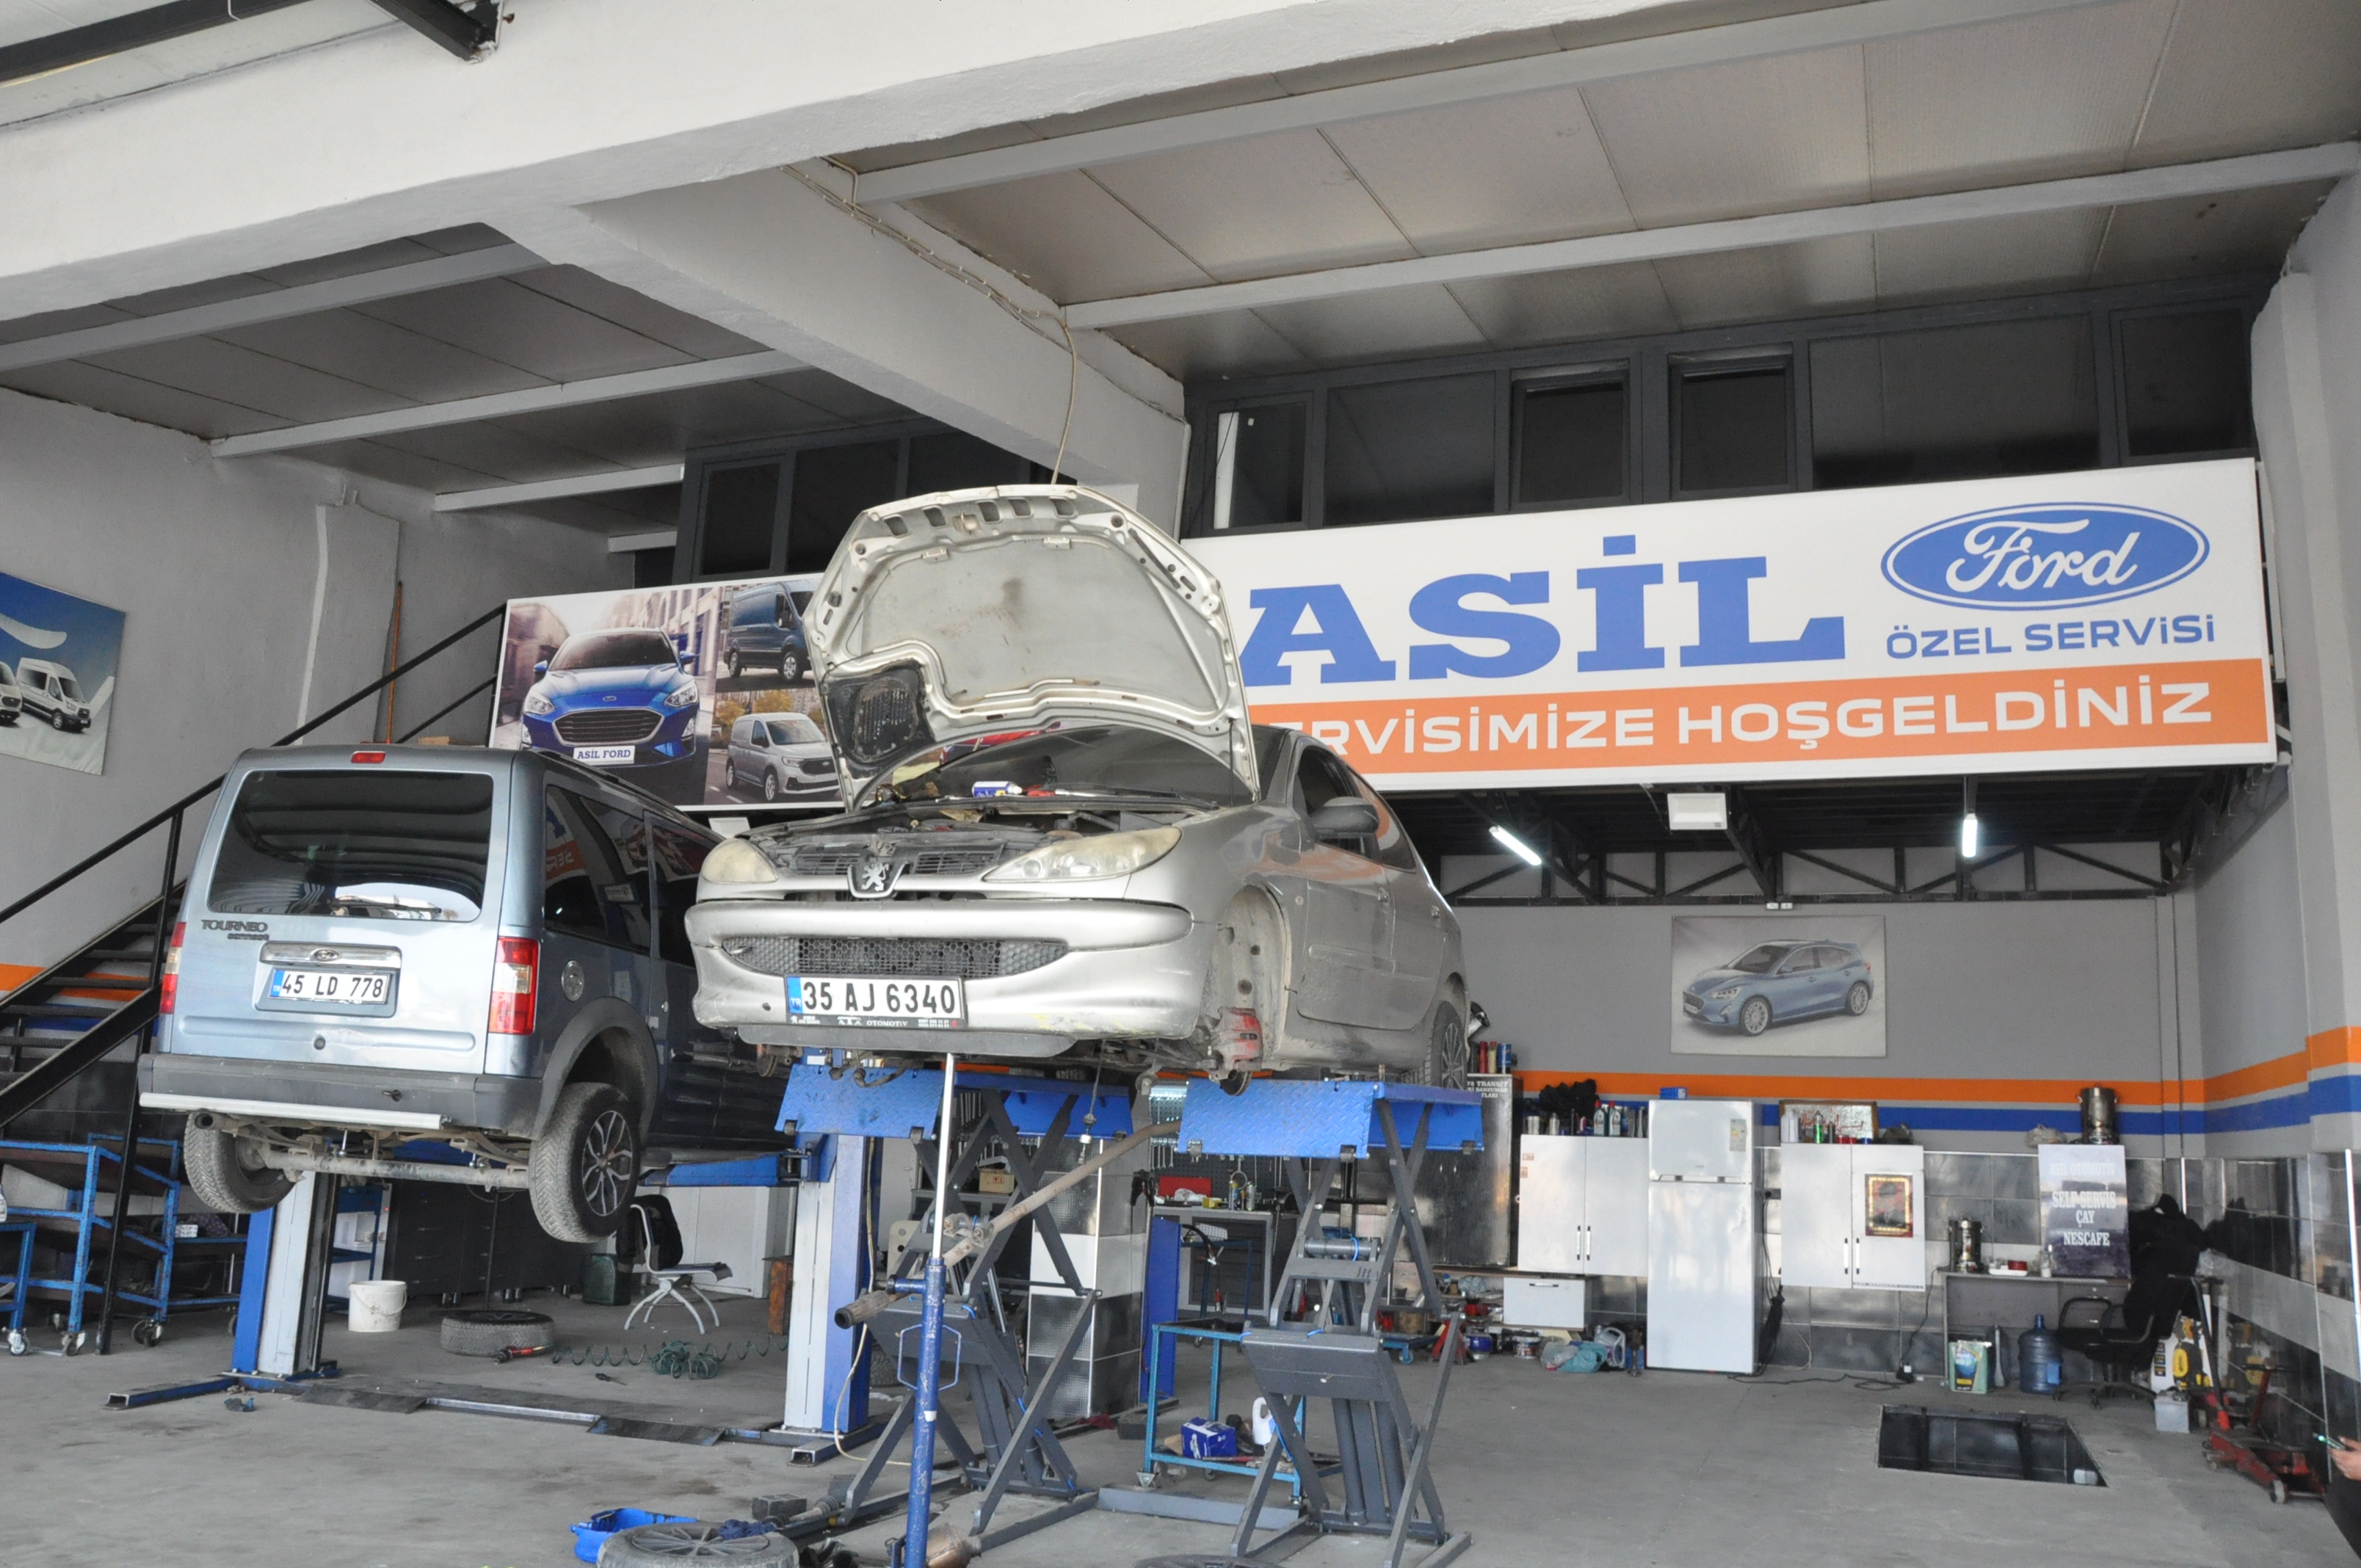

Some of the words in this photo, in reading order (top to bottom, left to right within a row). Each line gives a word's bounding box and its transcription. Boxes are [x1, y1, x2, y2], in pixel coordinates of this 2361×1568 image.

[1945, 518, 2141, 592] Ford
[1238, 534, 1846, 687] ASİL
[1886, 624, 2012, 659] ÖZEL
[1269, 703, 1654, 755] RVİSİMİZE
[1678, 674, 2212, 750] HOŞGELDİNİZ
[577, 749, 601, 759] ASİL
[602, 749, 631, 758] FORD
[201, 919, 269, 932] TOURNEO
[282, 973, 305, 994] 45
[315, 976, 338, 995] LD
[350, 977, 383, 998] 778
[790, 998, 802, 1007] TR
[803, 981, 833, 1011] 35
[845, 982, 875, 1012] AJ
[885, 983, 955, 1014] 6340
[2075, 1210, 2095, 1228] ÇAY
[2063, 1232, 2111, 1246] NESCAFE
